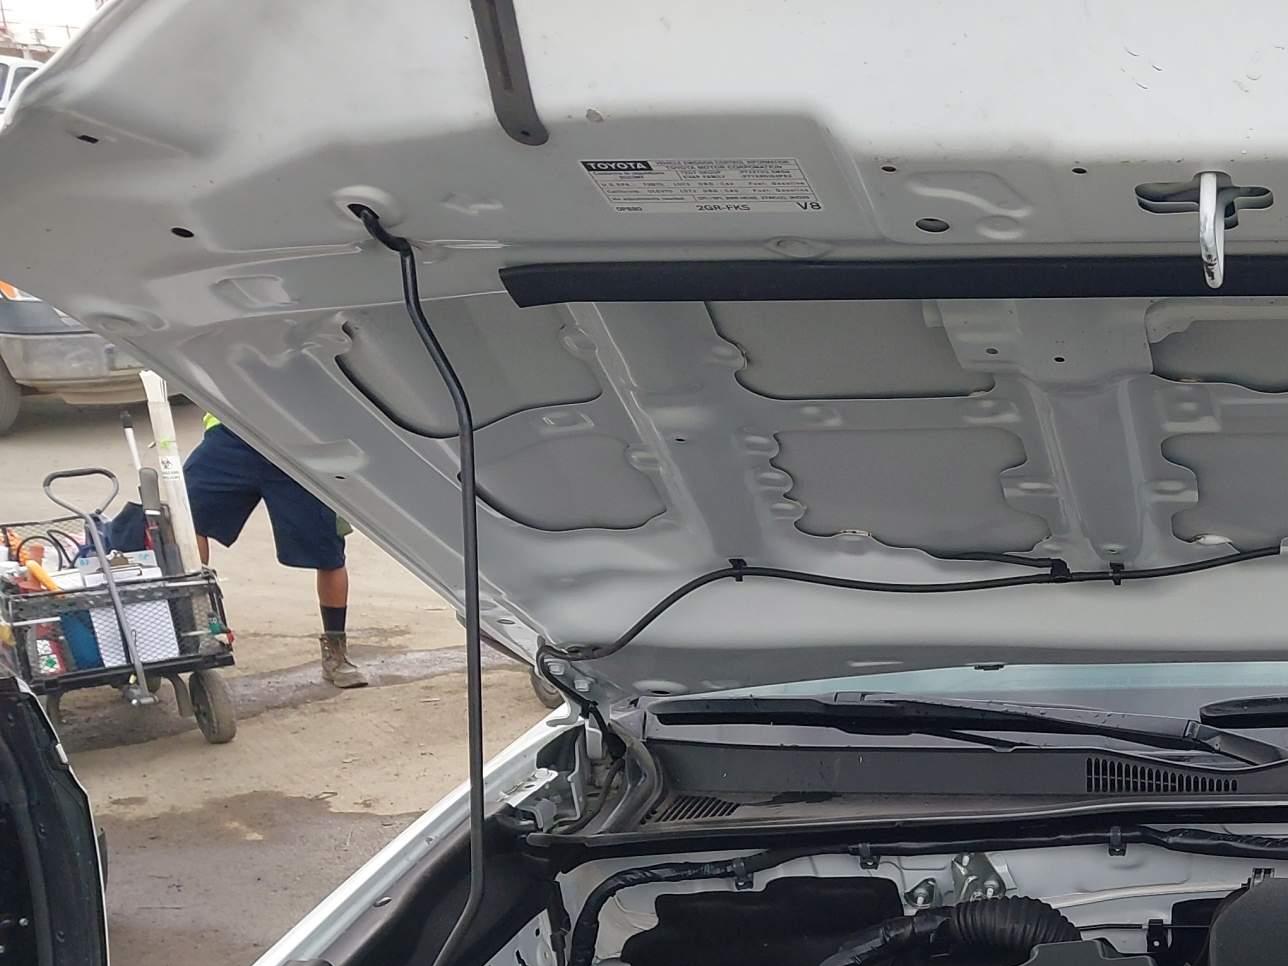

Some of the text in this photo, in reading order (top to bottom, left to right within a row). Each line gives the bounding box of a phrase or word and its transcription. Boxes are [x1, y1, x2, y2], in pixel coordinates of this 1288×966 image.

[586, 162, 648, 170] TOYOTA
[695, 201, 822, 212] 2GR-FKS V8
